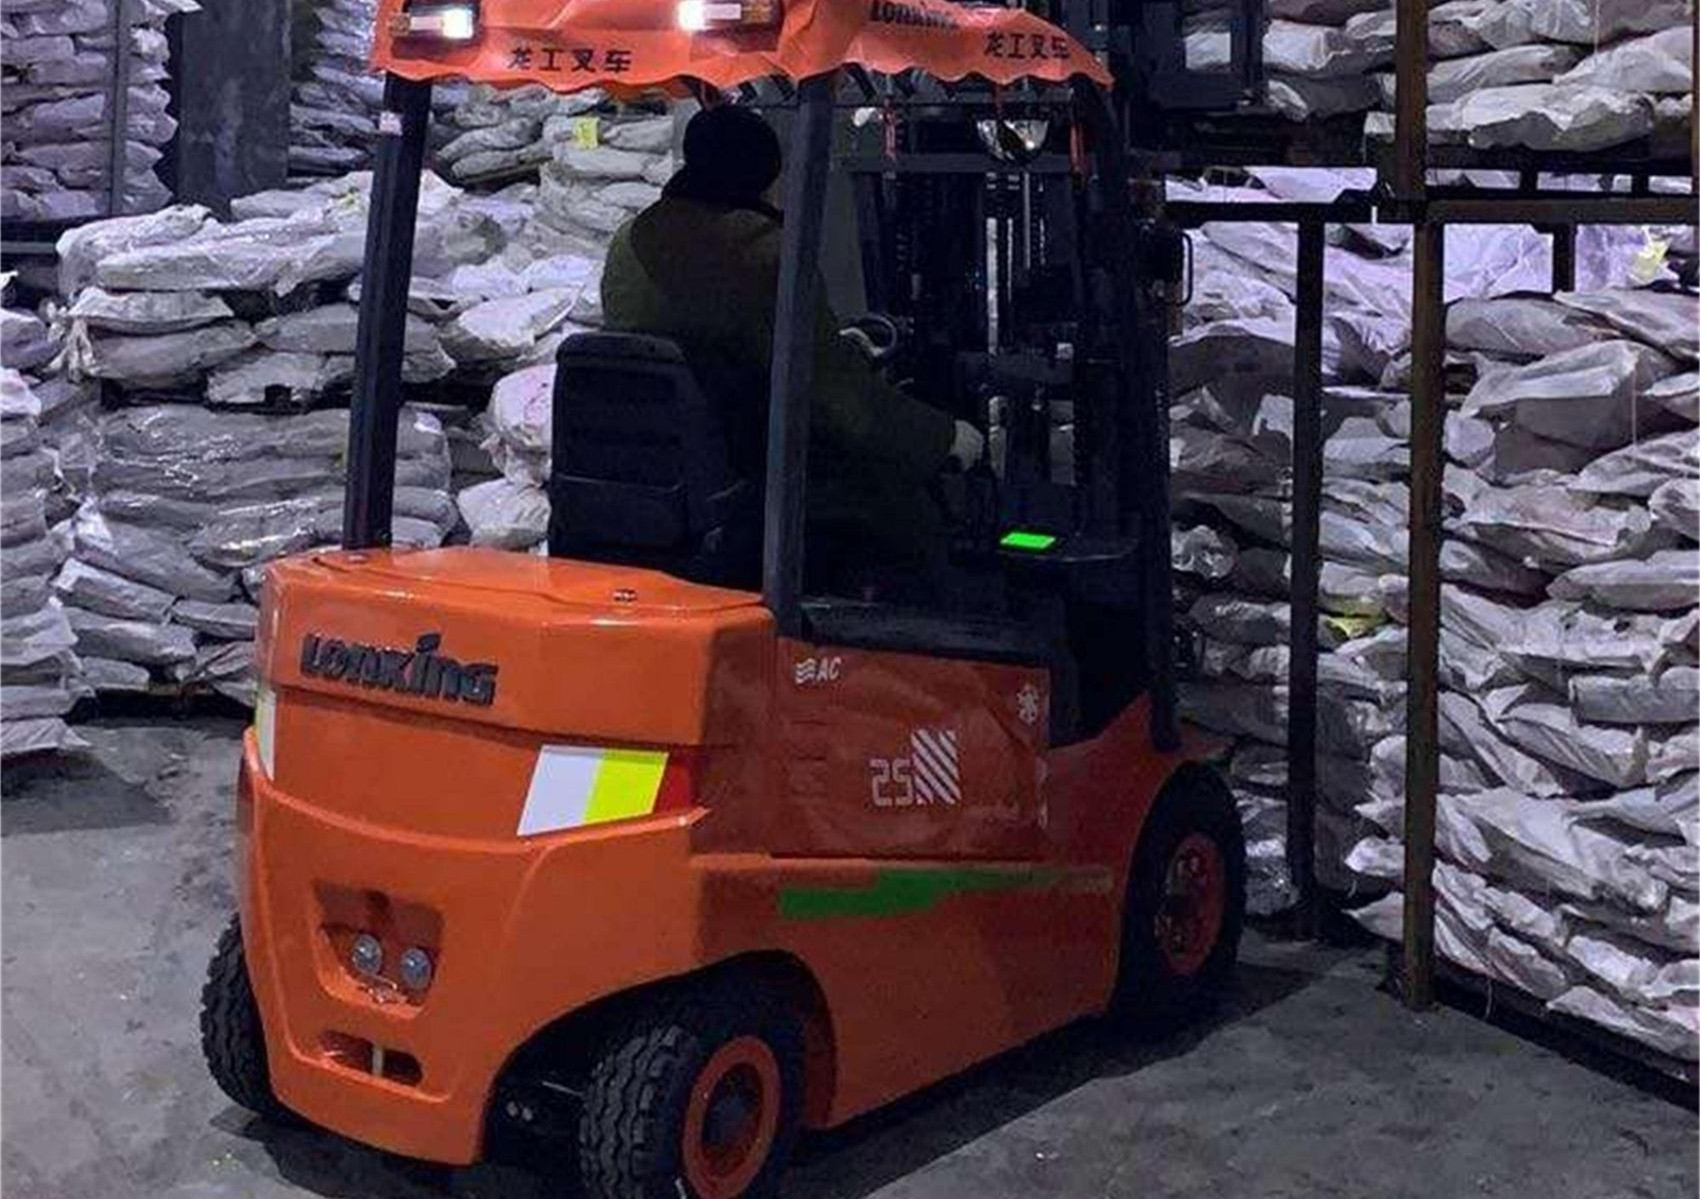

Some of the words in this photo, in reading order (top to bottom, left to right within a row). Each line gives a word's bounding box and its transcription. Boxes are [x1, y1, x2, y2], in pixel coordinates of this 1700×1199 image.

[984, 31, 1070, 59] 龙工叉车
[507, 46, 631, 73] 龙工叉车
[816, 656, 841, 682] AC
[869, 758, 914, 806] 25
